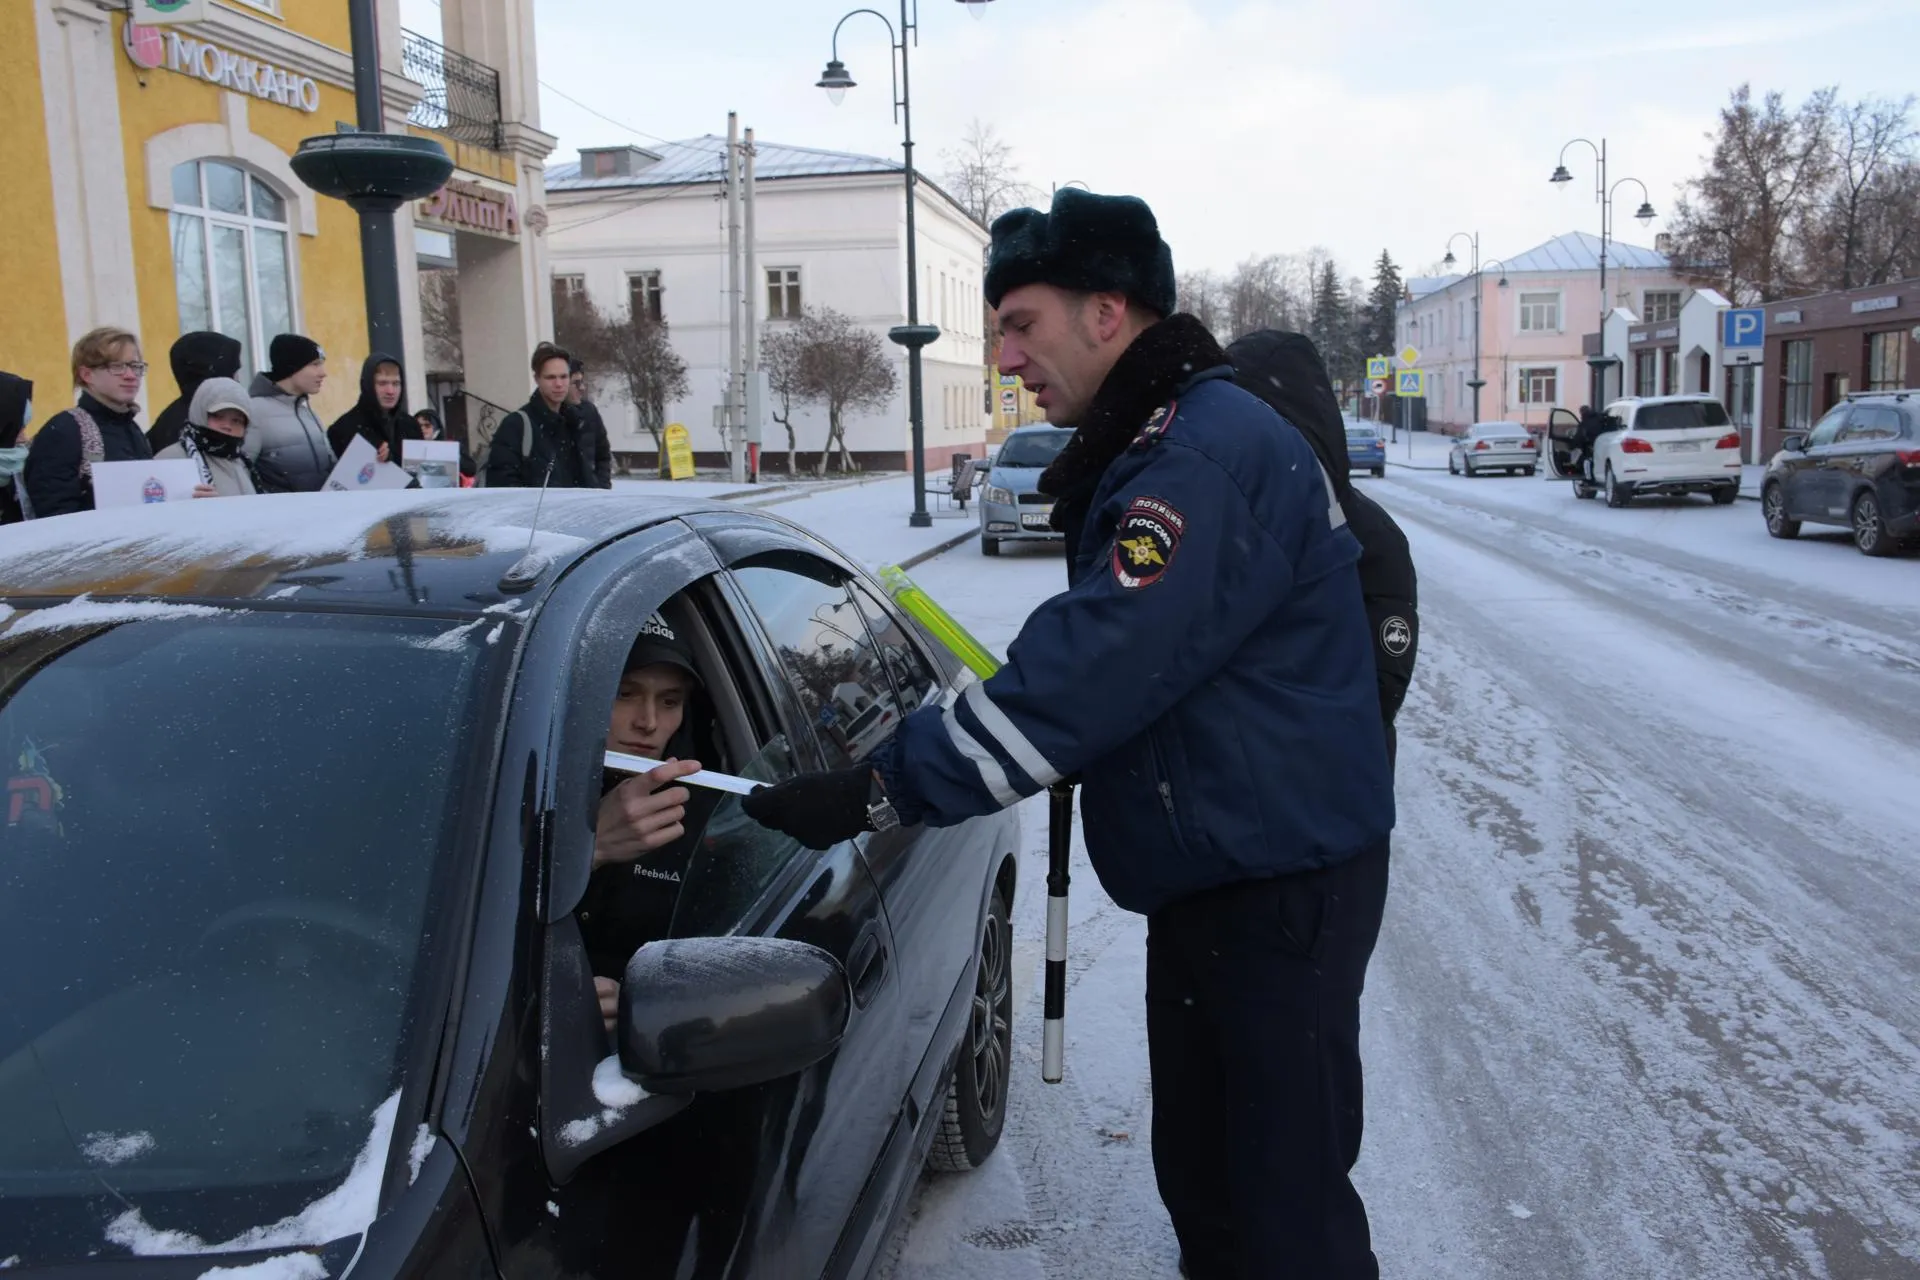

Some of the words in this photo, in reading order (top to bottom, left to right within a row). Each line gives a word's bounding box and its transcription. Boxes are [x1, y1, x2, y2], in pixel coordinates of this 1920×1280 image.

[165, 31, 320, 113] МОККАНО
[1733, 313, 1757, 344] P
[1136, 499, 1183, 528] ПОЛИЦИЯ
[1128, 518, 1172, 548] РОССИЯ
[633, 864, 671, 881] Reebok
